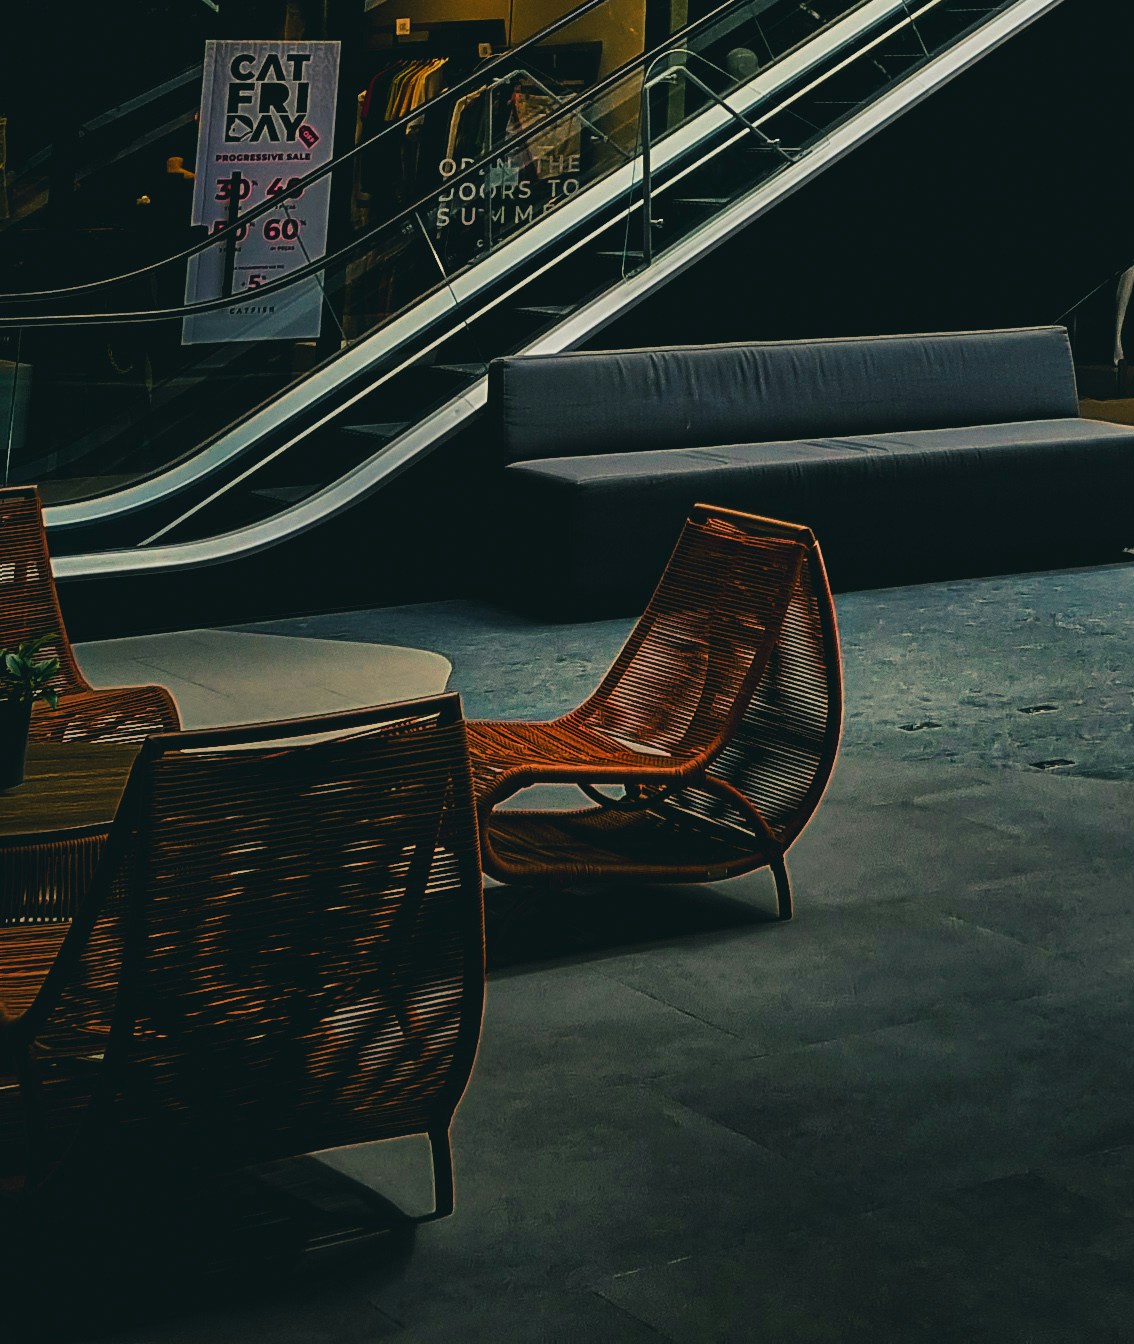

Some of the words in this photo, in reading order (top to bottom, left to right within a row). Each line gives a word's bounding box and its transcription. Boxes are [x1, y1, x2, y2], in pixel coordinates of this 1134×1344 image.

[230, 53, 312, 82] CAT
[226, 82, 310, 114] FRI
[224, 114, 307, 143] DAY
[215, 153, 284, 162] PROGRESSIVE
[286, 152, 312, 161] SALE
[532, 154, 581, 175] THE
[547, 178, 580, 198] TO
[229, 305, 275, 315] CATFISH
